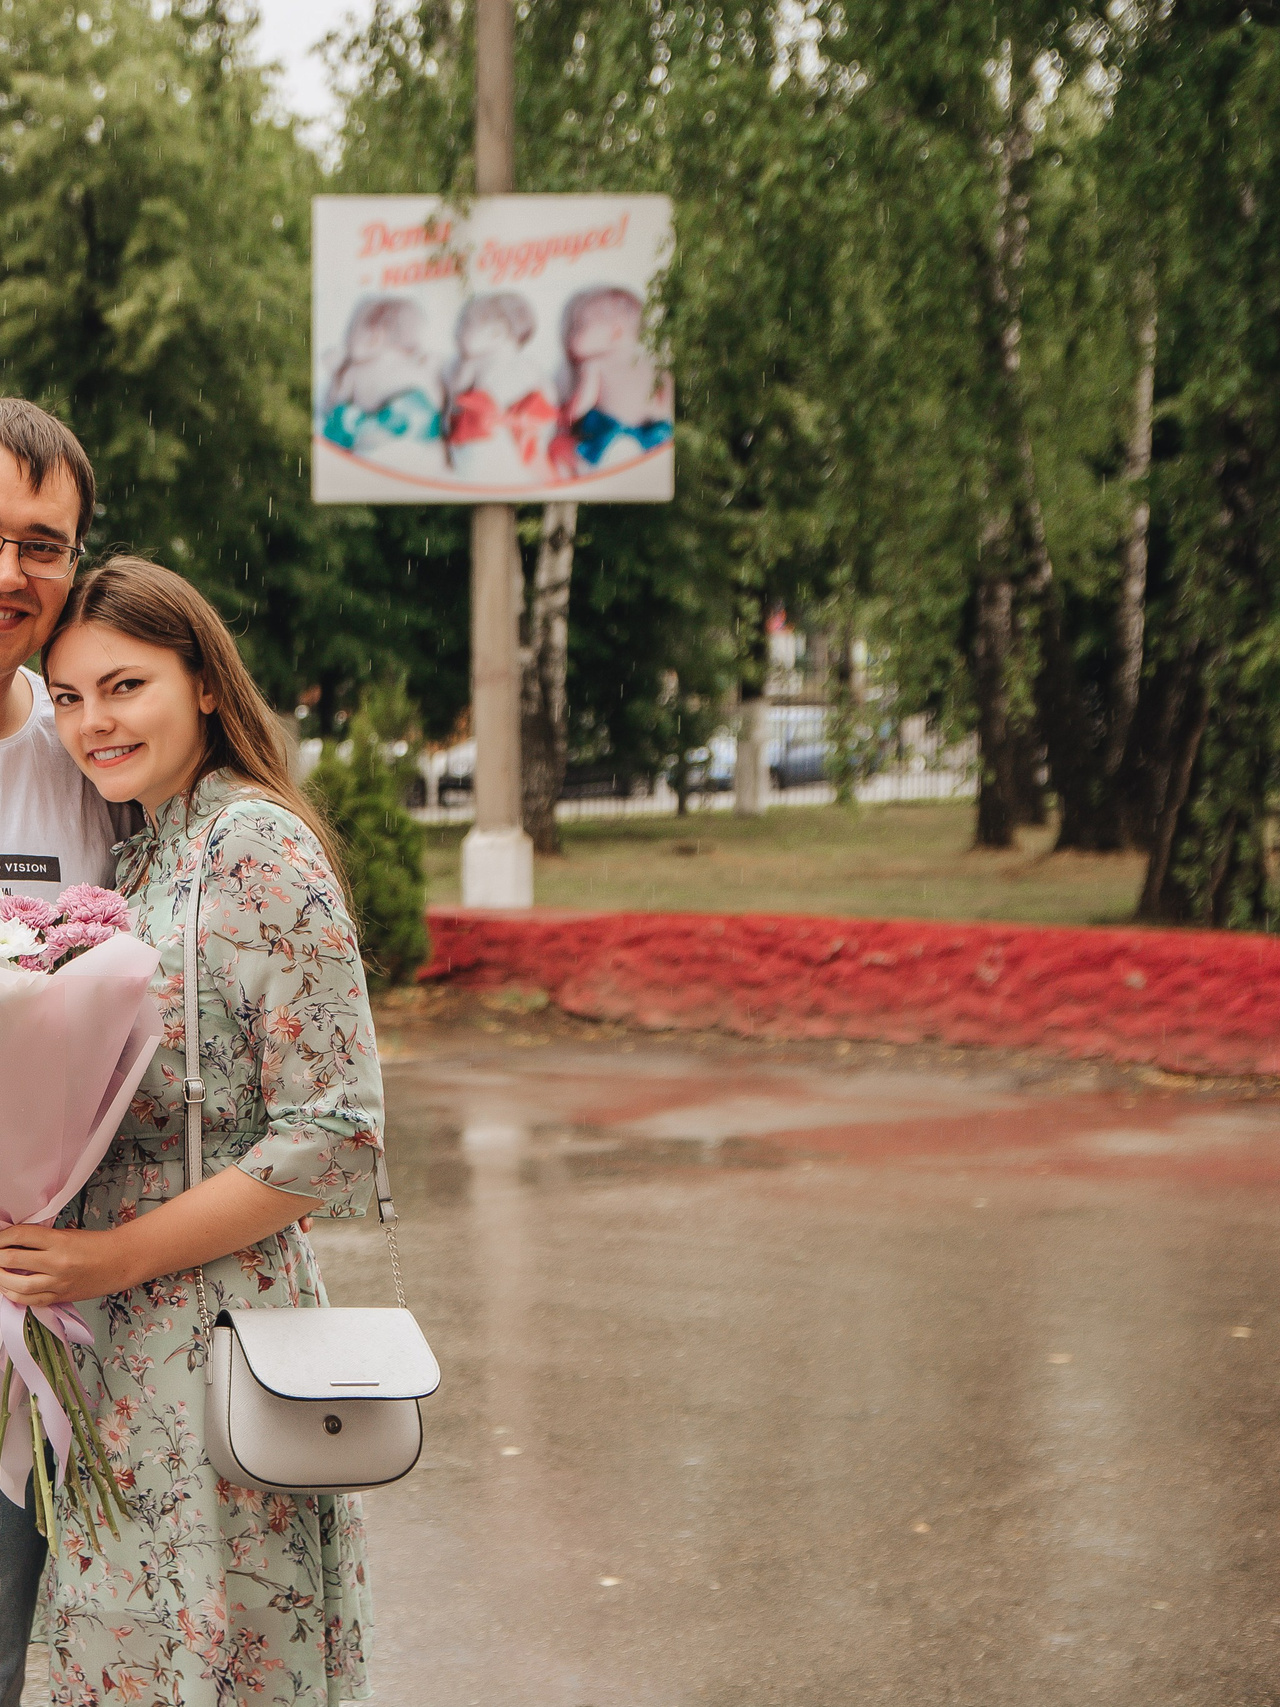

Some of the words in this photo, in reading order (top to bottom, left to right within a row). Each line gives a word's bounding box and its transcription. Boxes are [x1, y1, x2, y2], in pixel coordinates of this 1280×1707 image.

[358, 219, 452, 258] Дети
[476, 212, 631, 285] будущее!
[5, 862, 48, 873] VISION
